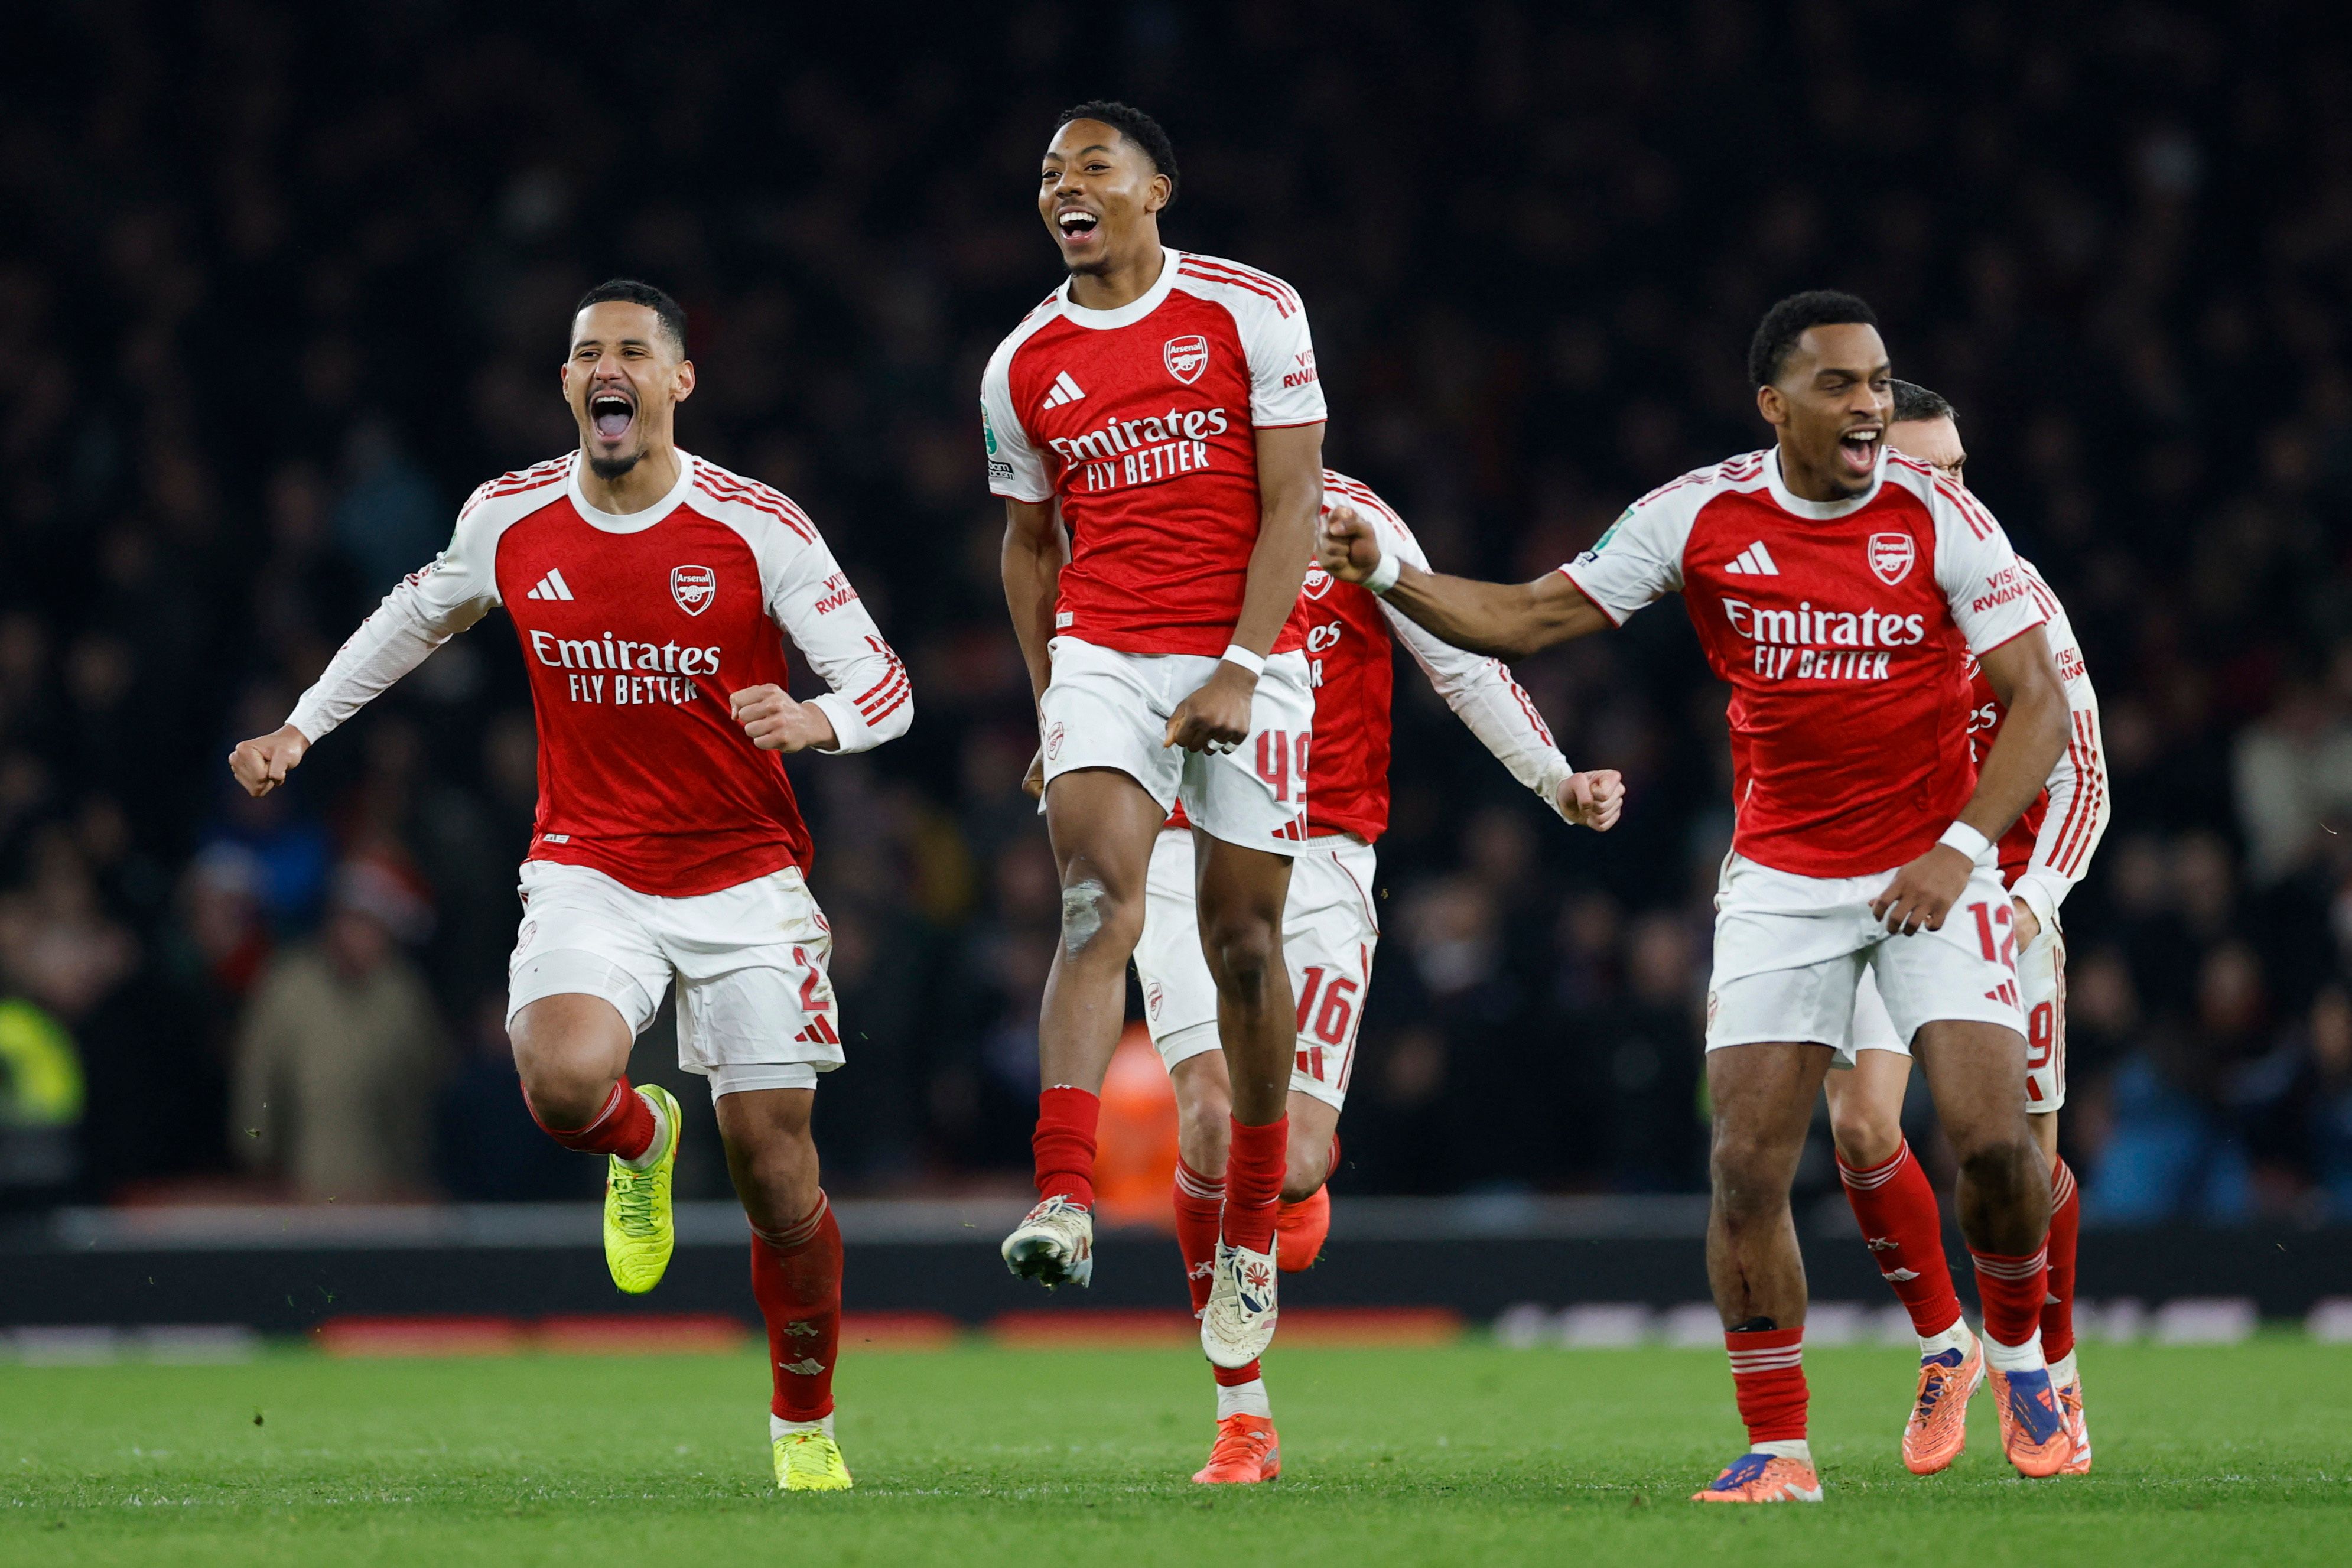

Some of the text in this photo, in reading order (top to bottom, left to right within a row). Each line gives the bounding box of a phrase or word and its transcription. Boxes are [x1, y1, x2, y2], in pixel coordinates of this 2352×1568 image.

[1170, 343, 1201, 354] Arsenal
[1049, 407, 1228, 470] Emirates
[1086, 441, 1209, 492] FLY BETTER
[677, 574, 709, 582] Arsenal
[1722, 598, 1925, 646] Emirates
[529, 629, 720, 675] Emirates
[1755, 645, 1891, 680] FLY BETTER
[569, 674, 698, 705] FLY BETTER
[1255, 729, 1312, 804] 49
[1967, 902, 2016, 976] 12
[792, 945, 831, 1012] 2
[1296, 966, 1359, 1046] 16
